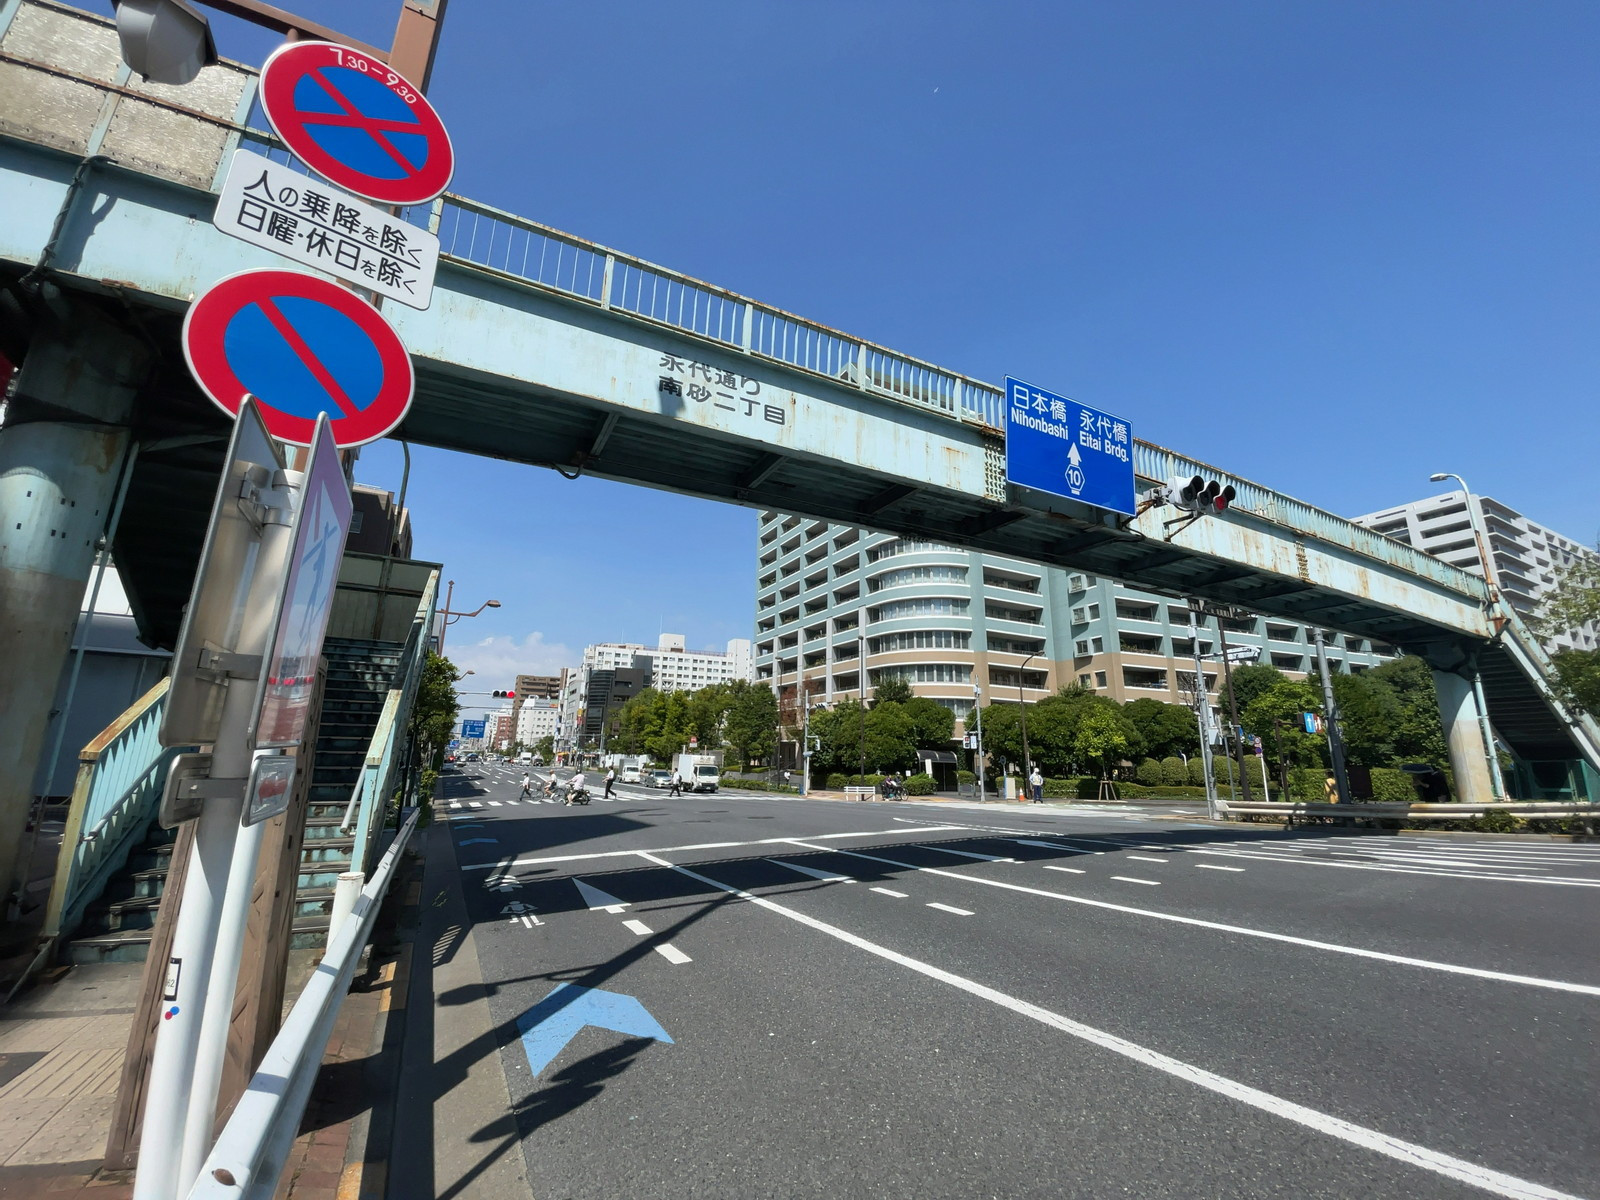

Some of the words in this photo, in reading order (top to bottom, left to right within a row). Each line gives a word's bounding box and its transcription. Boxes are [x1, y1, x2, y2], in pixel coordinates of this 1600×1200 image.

[243, 169, 423, 265] 人の乗降を除く
[237, 197, 417, 296] 日曜・休日を除く
[658, 351, 761, 396] 永代通り
[658, 375, 786, 426] 南砂二丁目
[1011, 406, 1069, 441] Nihonbashi
[1079, 430, 1102, 452] Eitai
[1104, 438, 1130, 463] Brdg.
[1013, 384, 1067, 423] 日本橋
[1079, 409, 1128, 445] 永代橋
[1068, 468, 1081, 486] 10
